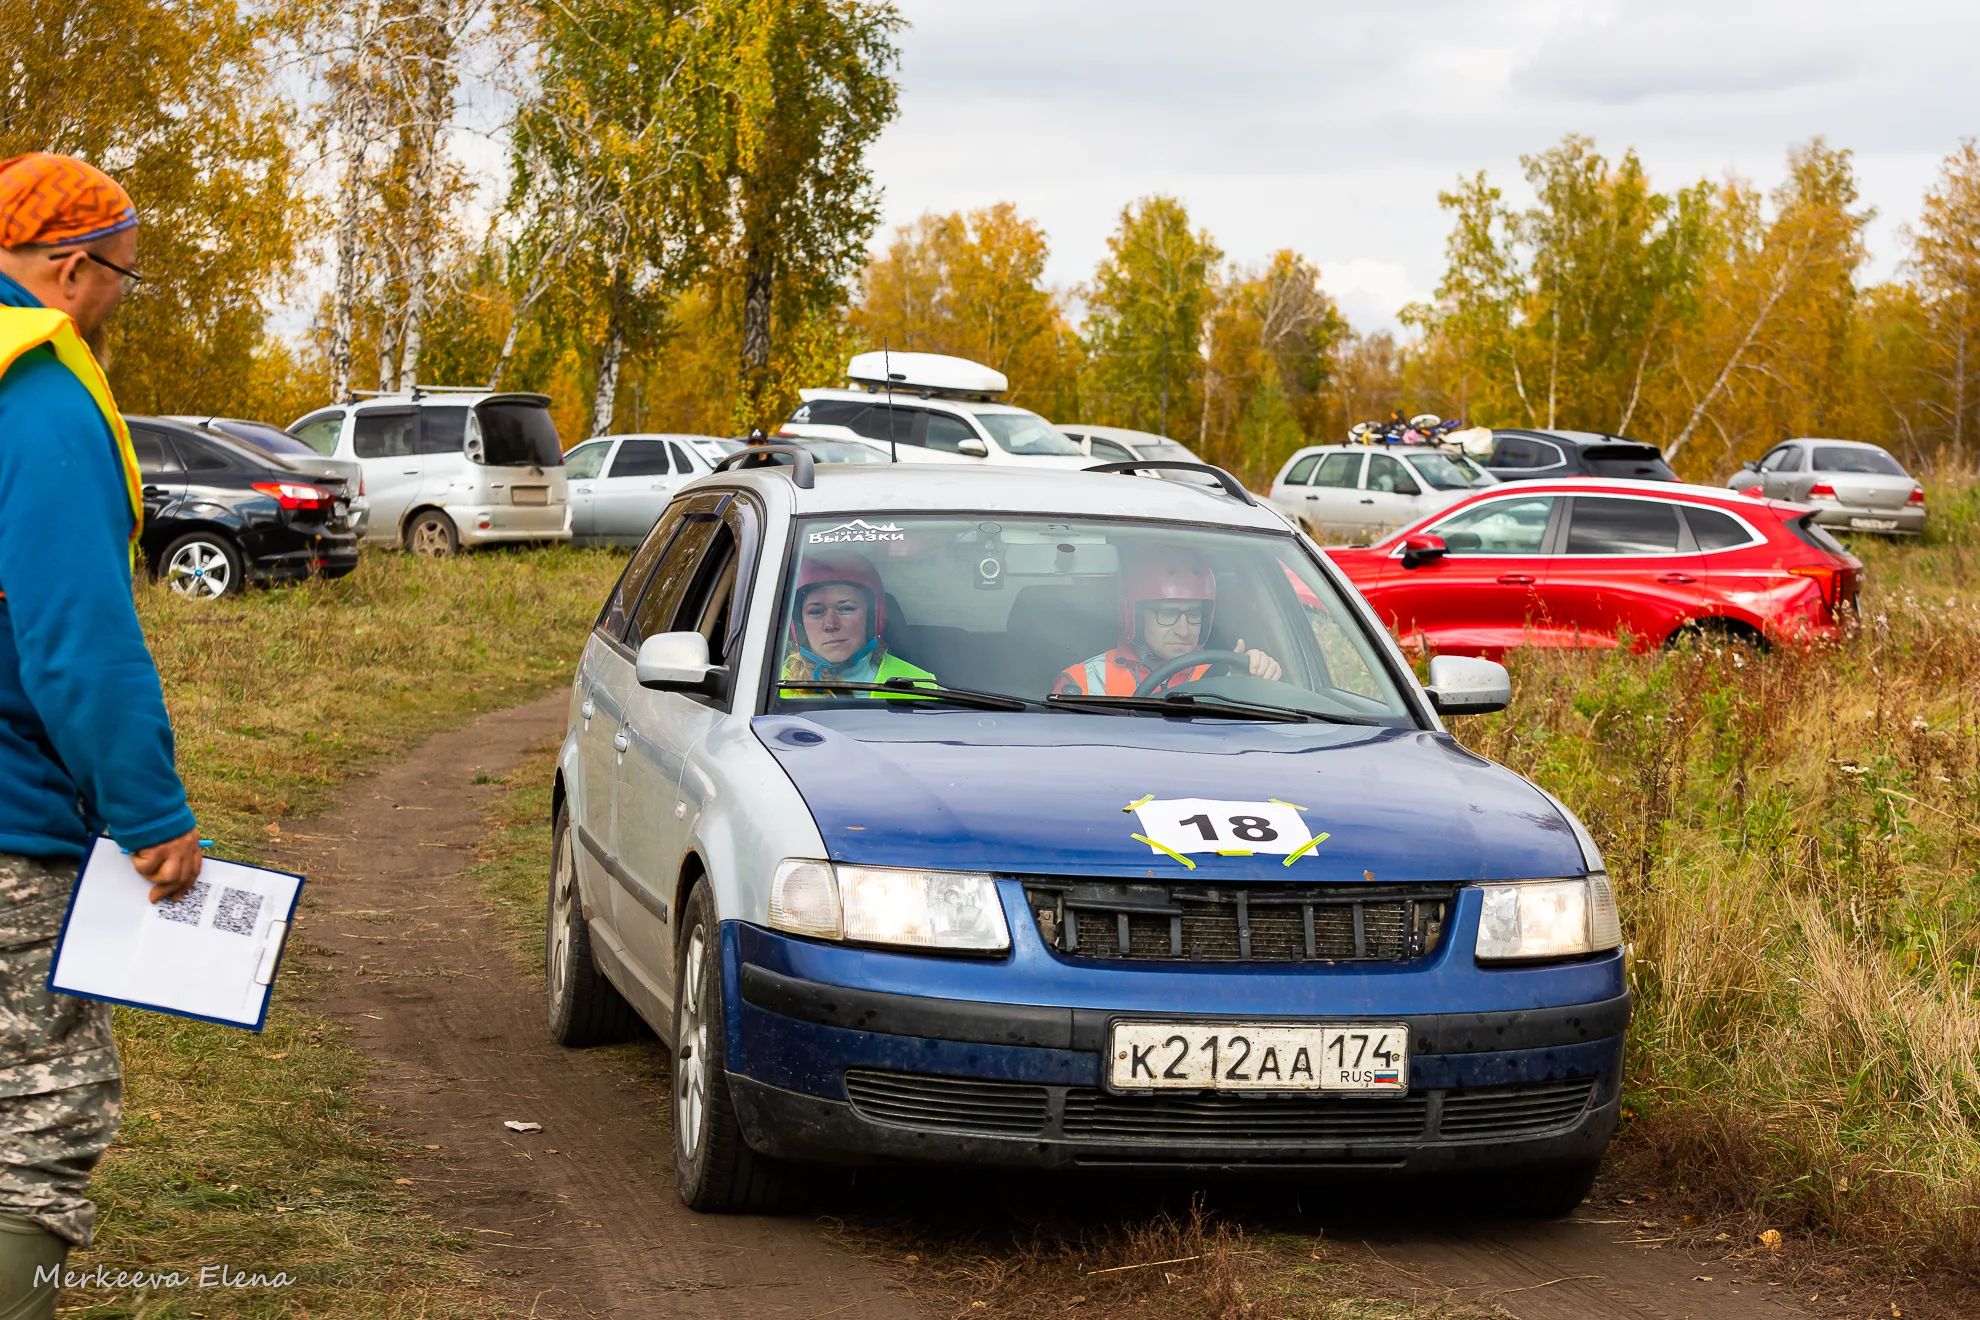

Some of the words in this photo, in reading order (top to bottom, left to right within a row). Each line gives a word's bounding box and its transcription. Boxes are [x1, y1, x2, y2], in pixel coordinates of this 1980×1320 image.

[1178, 814, 1279, 842] 18
[1328, 1034, 1391, 1069] 174
[1340, 1070, 1373, 1083] RUS
